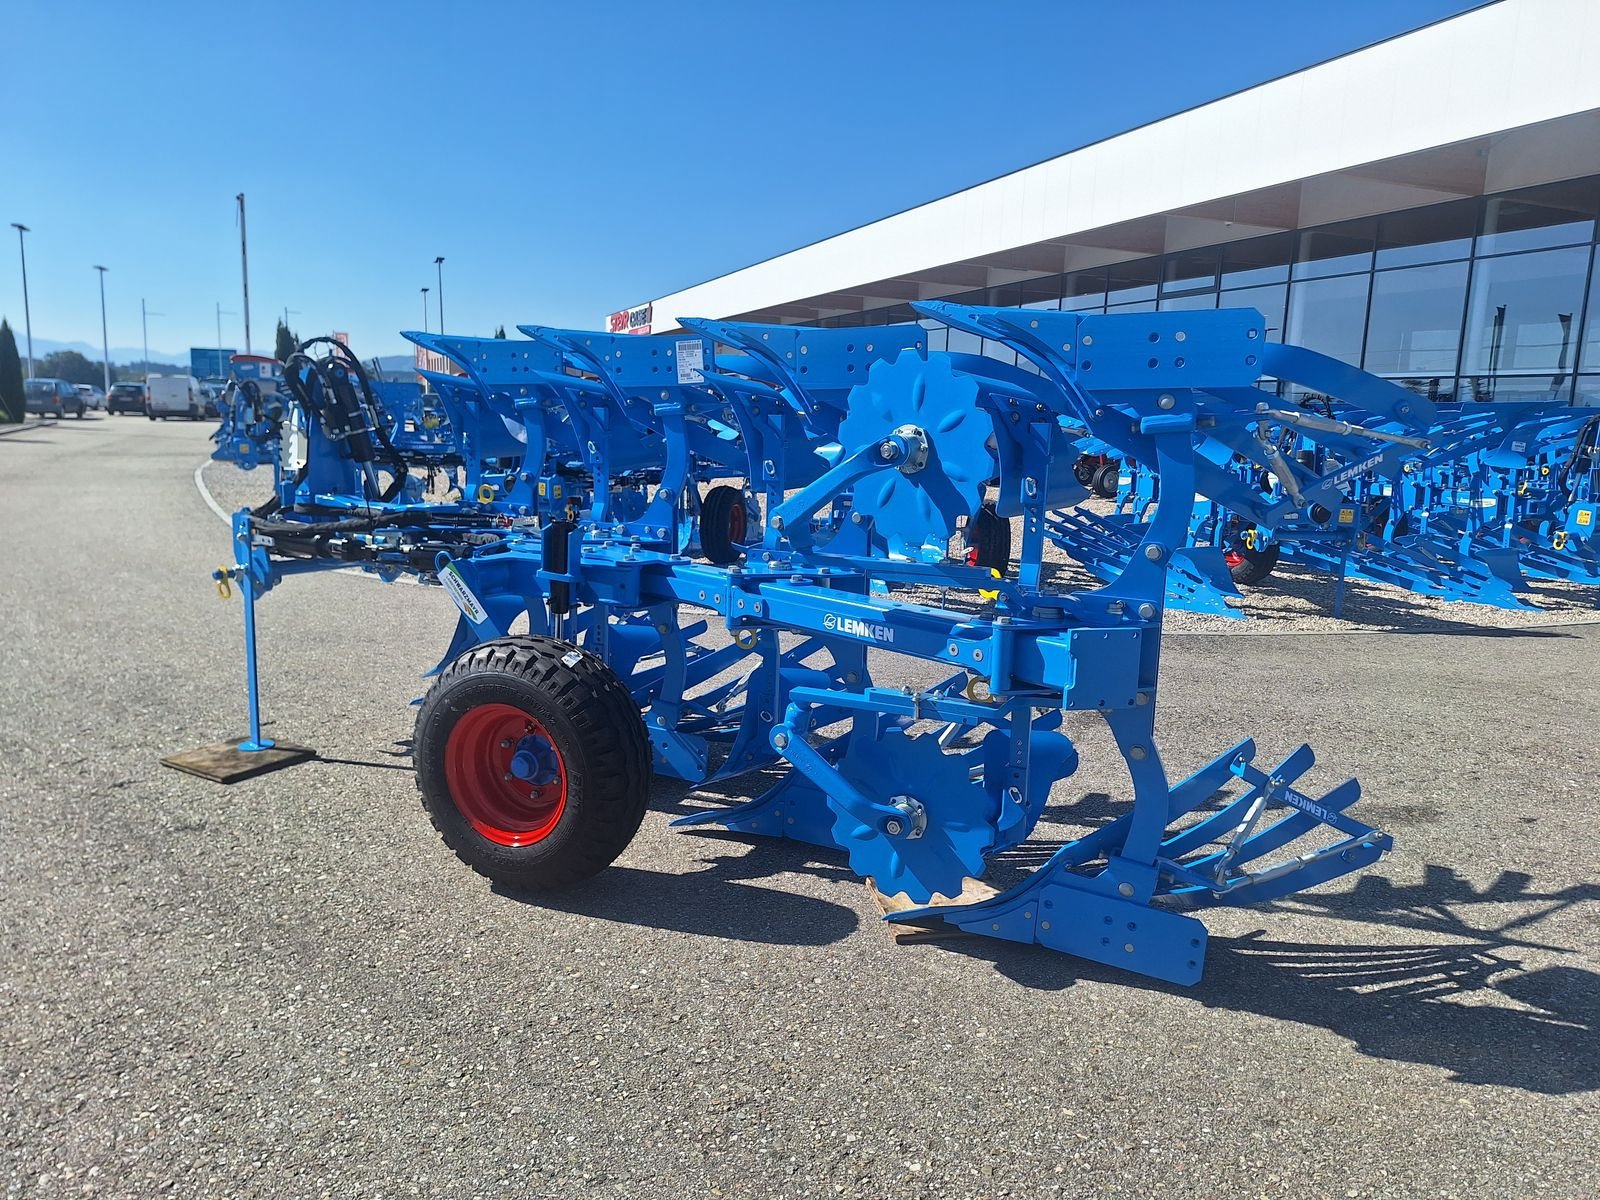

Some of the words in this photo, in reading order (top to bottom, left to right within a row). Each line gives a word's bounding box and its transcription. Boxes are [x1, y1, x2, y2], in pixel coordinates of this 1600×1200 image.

[1333, 453, 1384, 485] LEMKEN
[448, 571, 480, 615] SCHWARZMAYR
[836, 616, 894, 643] LEMKEN
[1284, 790, 1328, 820] LEMKEN
